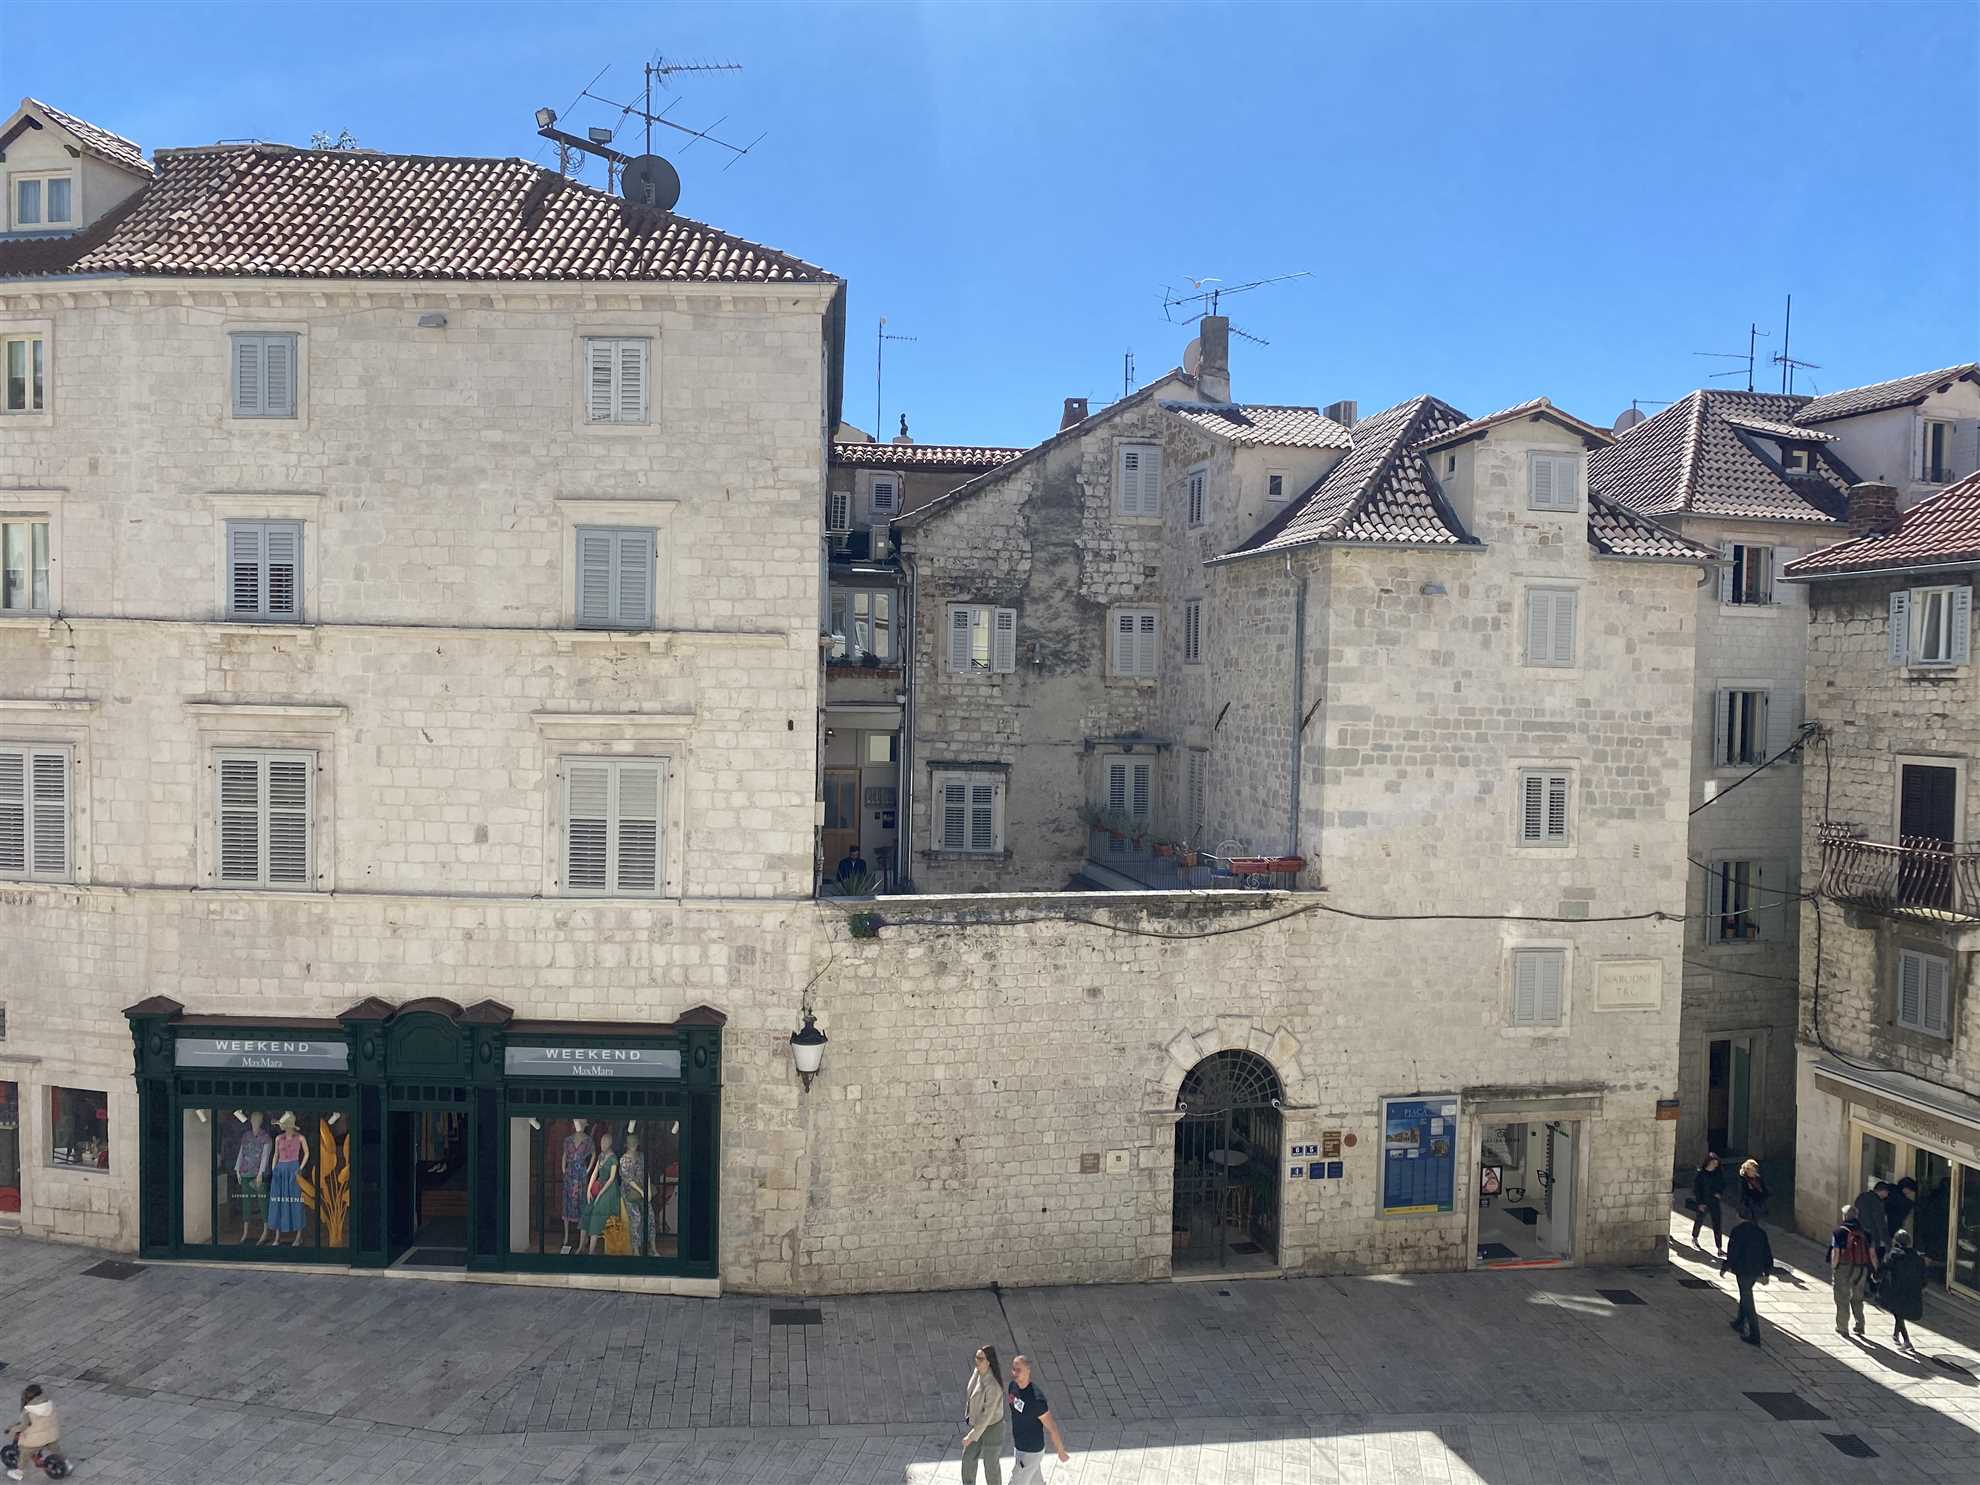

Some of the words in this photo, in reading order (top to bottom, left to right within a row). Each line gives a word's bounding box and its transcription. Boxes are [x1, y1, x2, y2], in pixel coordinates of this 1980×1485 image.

[215, 1040, 310, 1052] WEEKEND
[545, 1049, 641, 1060] WEEKEND
[241, 1056, 283, 1068] MaxMara
[572, 1065, 615, 1077] MaxMara
